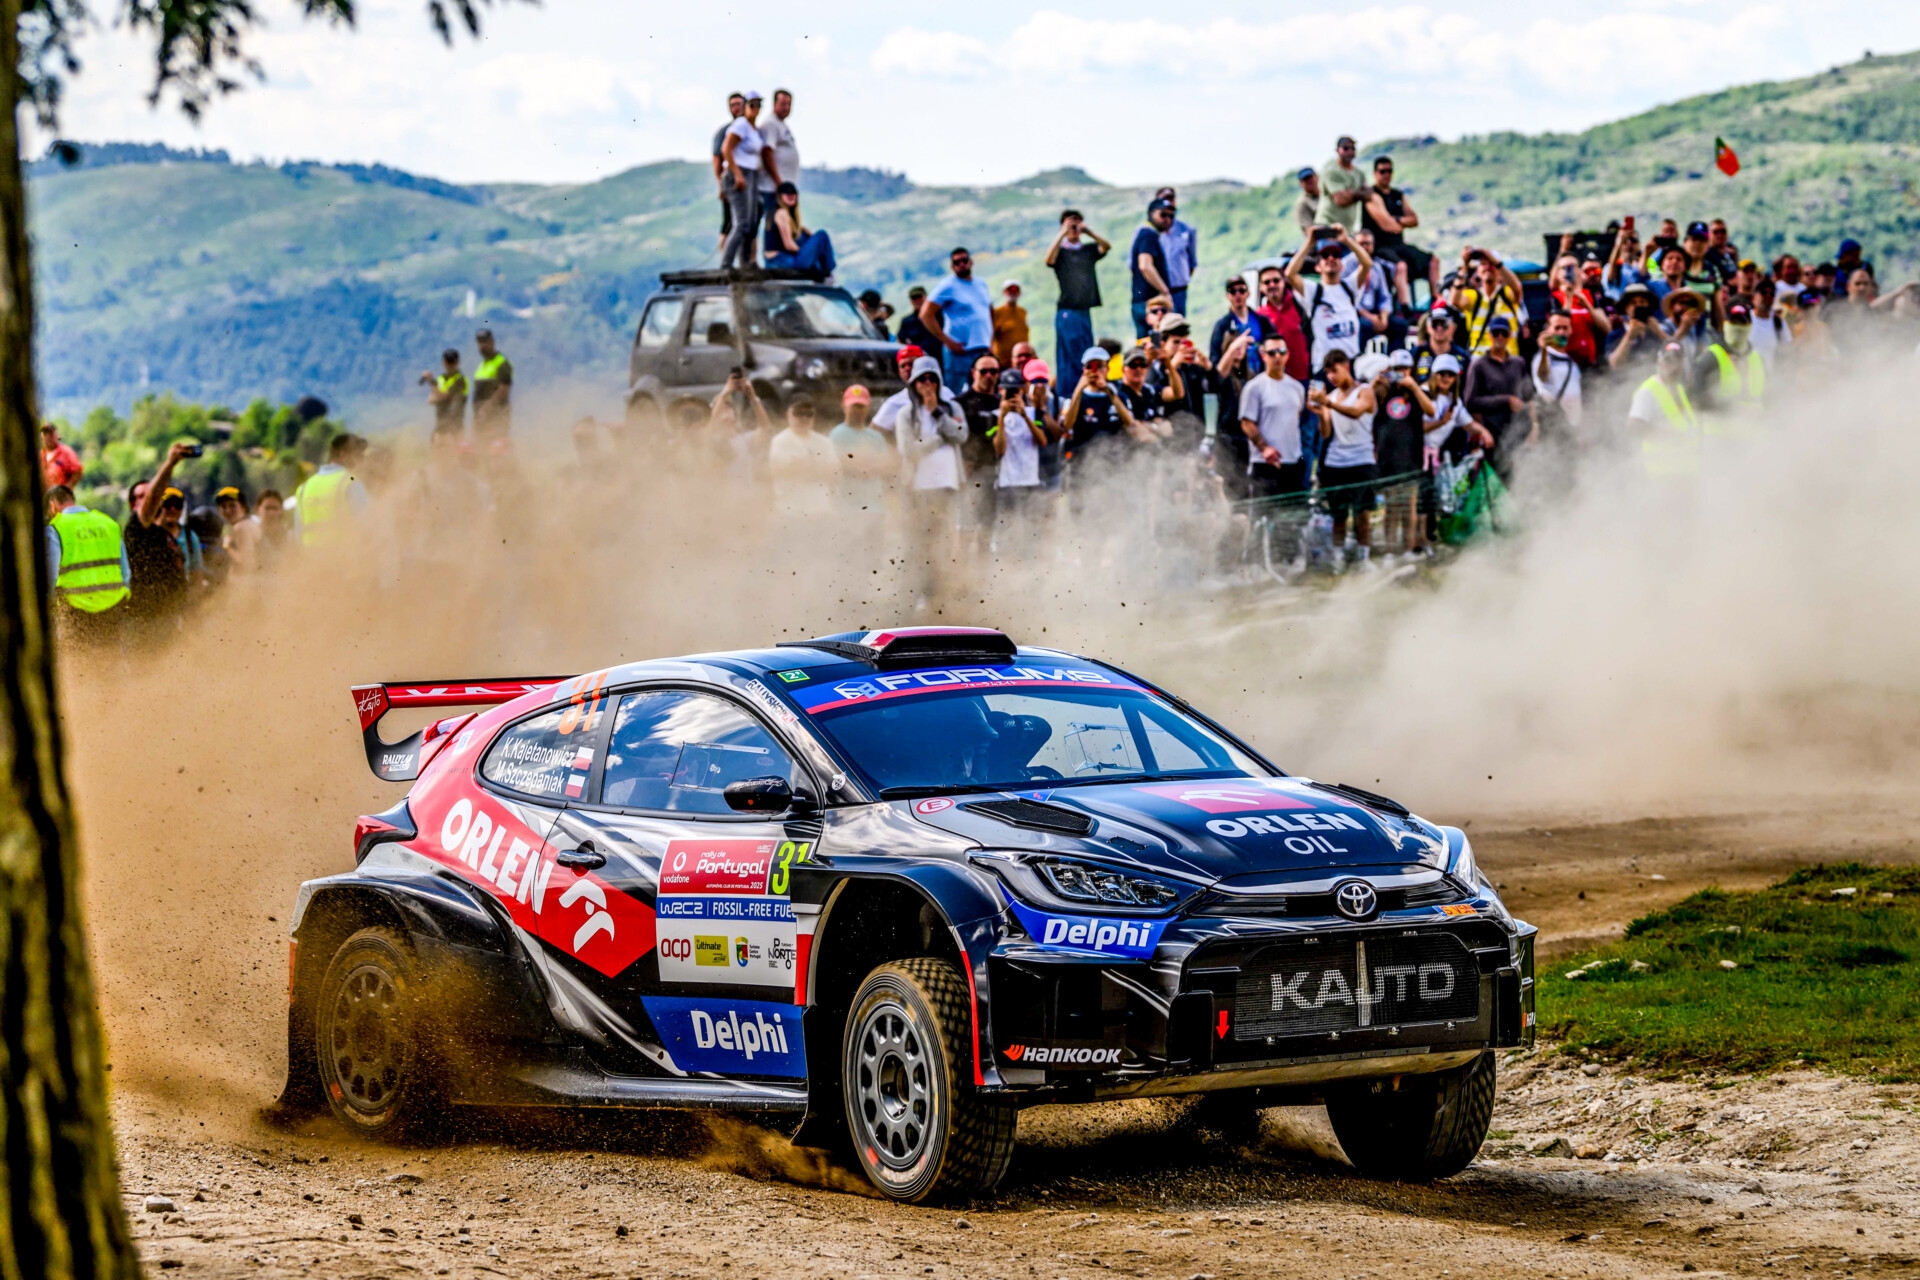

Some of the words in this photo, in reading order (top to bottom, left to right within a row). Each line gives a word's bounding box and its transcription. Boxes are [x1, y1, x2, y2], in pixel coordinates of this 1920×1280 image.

[875, 668, 1111, 690] FORUM8
[558, 672, 609, 735] 31
[493, 760, 565, 794] M.Szczepaniak
[1206, 813, 1367, 838] ORLEN
[441, 798, 554, 915] ORLEN
[1284, 836, 1348, 855] OIL
[663, 874, 690, 884] vodafone
[696, 859, 765, 877] Portugal
[660, 902, 703, 915] WRC2
[712, 903, 771, 917] FOSSIL-FREE
[696, 941, 721, 950] ultimate
[1043, 918, 1152, 950] Delphi
[661, 938, 691, 962] acp
[690, 1010, 789, 1060] Delphi
